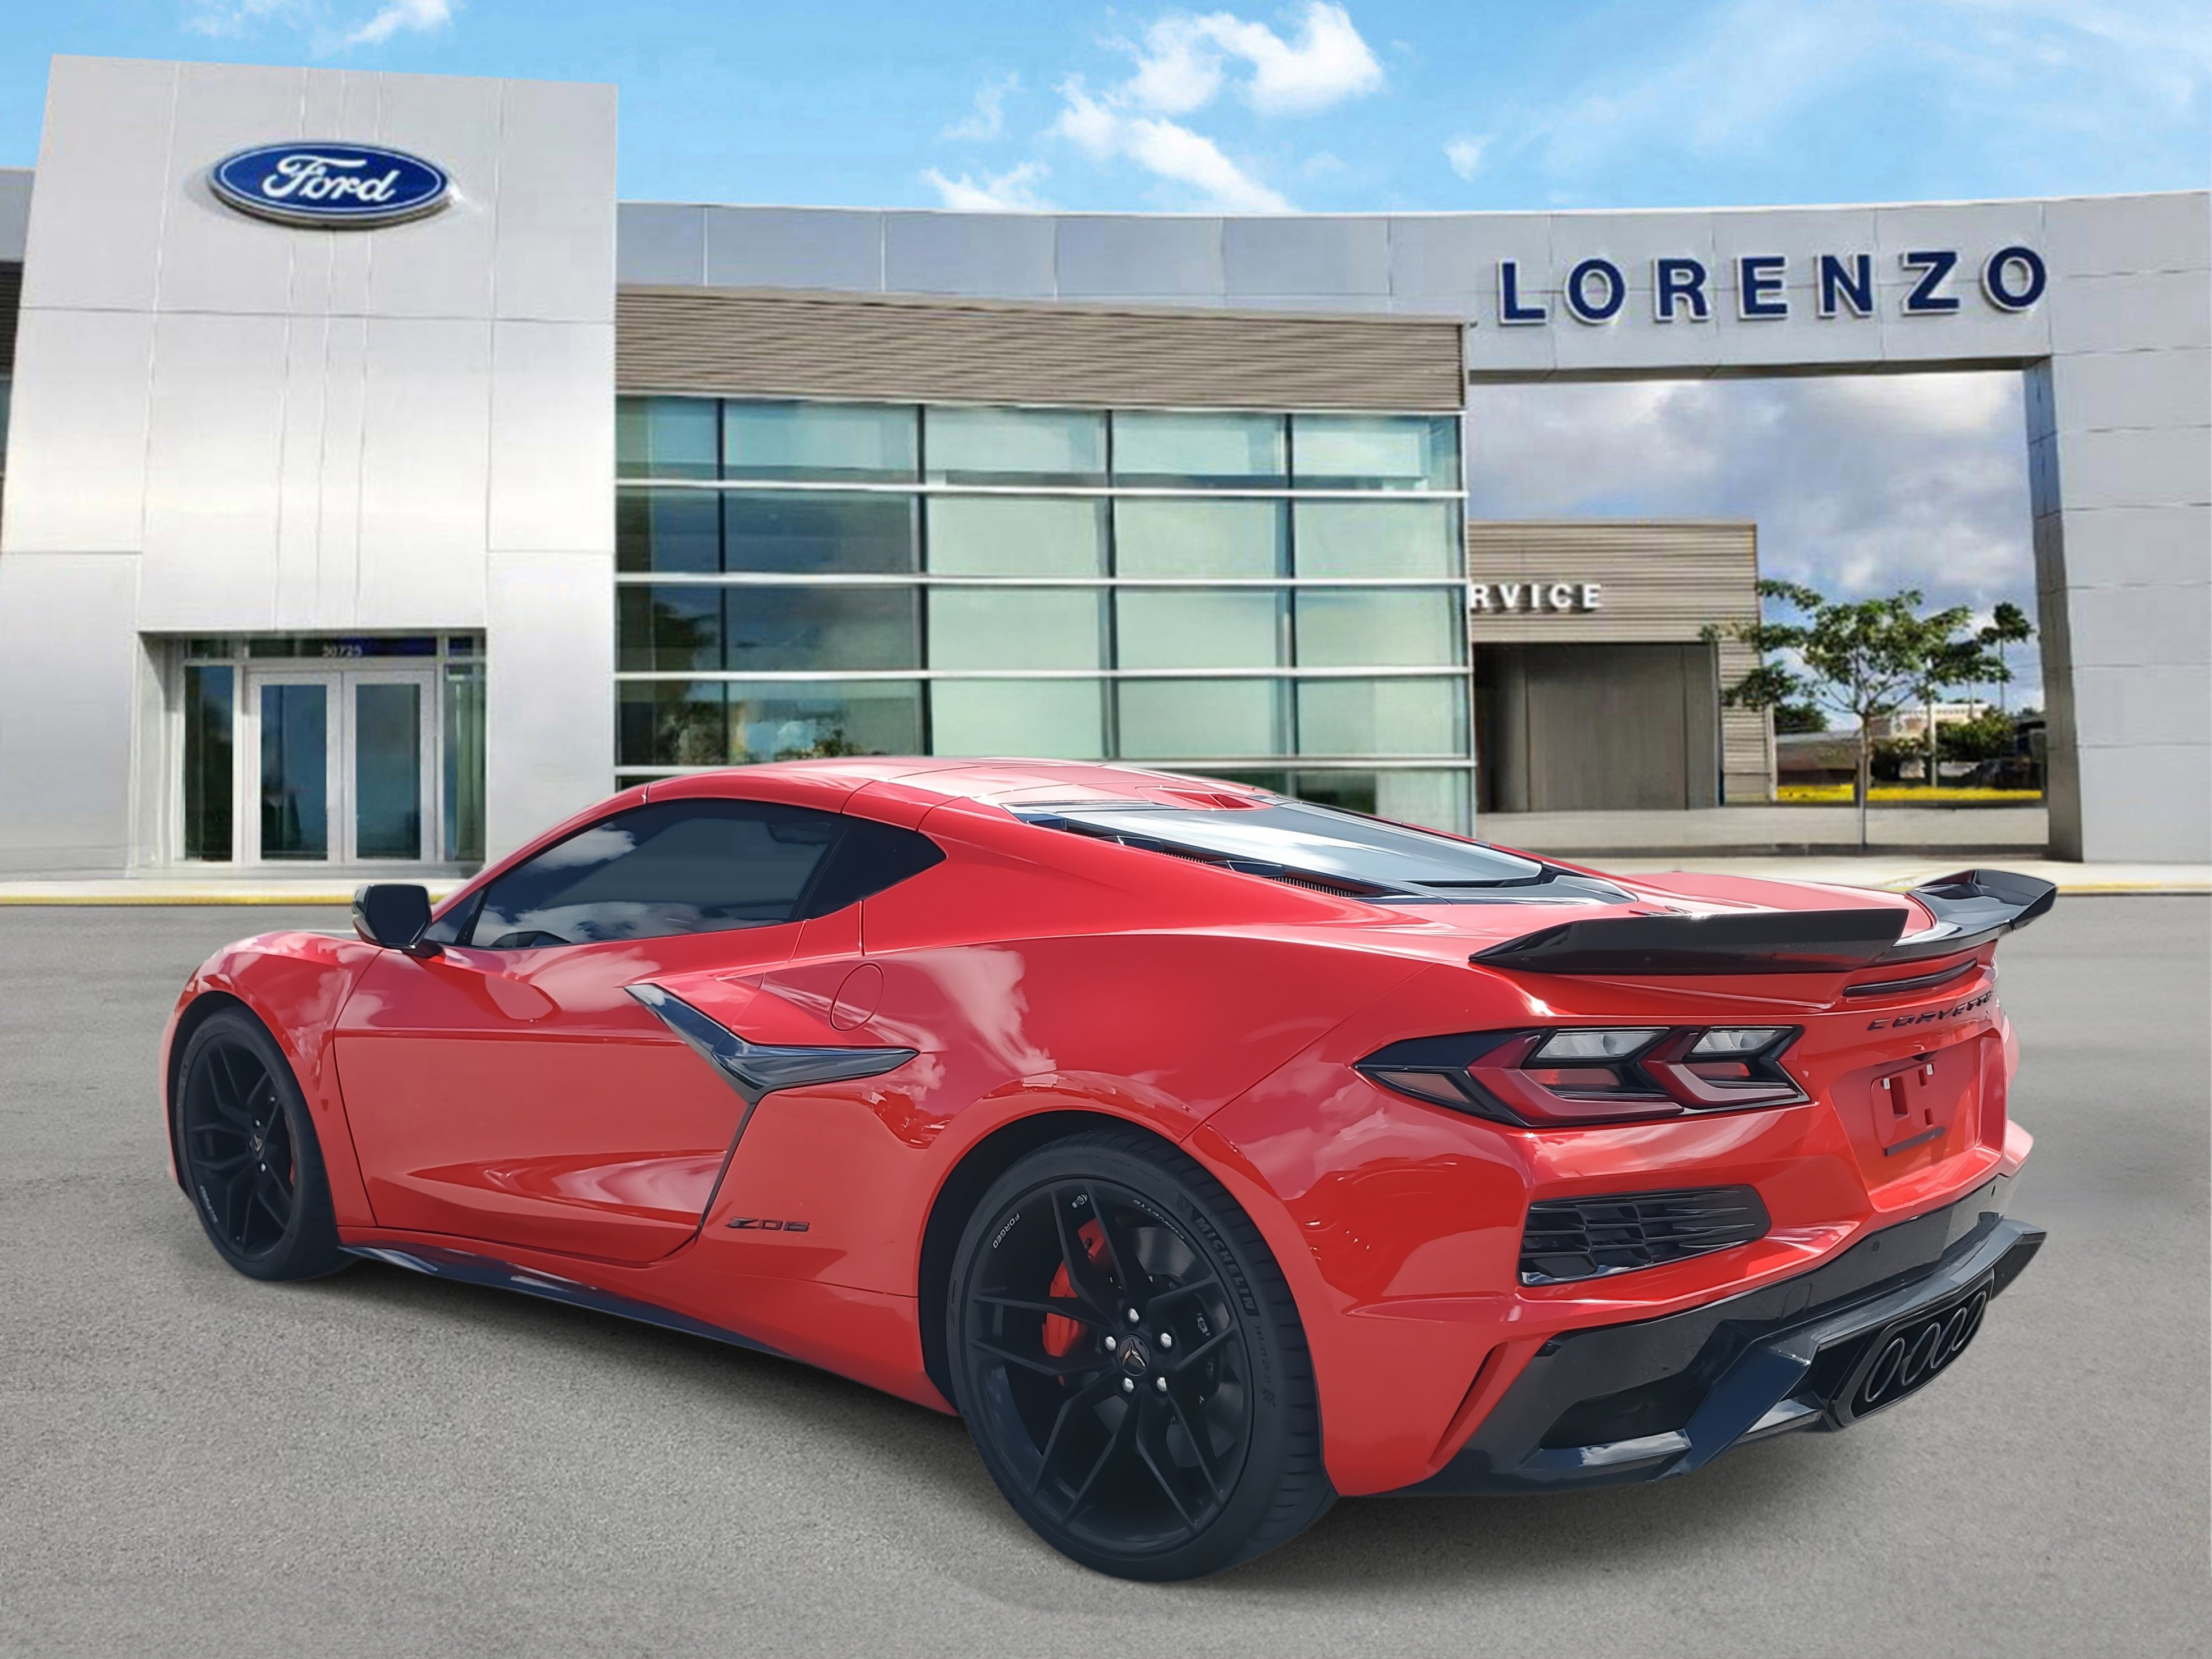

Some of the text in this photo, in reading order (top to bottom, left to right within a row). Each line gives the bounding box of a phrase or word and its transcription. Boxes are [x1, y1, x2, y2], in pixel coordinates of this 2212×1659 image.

[262, 154, 401, 201] Ford
[1497, 246, 2047, 324] LORENZO
[725, 1216, 810, 1232] Z06
[992, 1212, 1020, 1249] FORGED
[1194, 1217, 1256, 1309] MICHELIN
